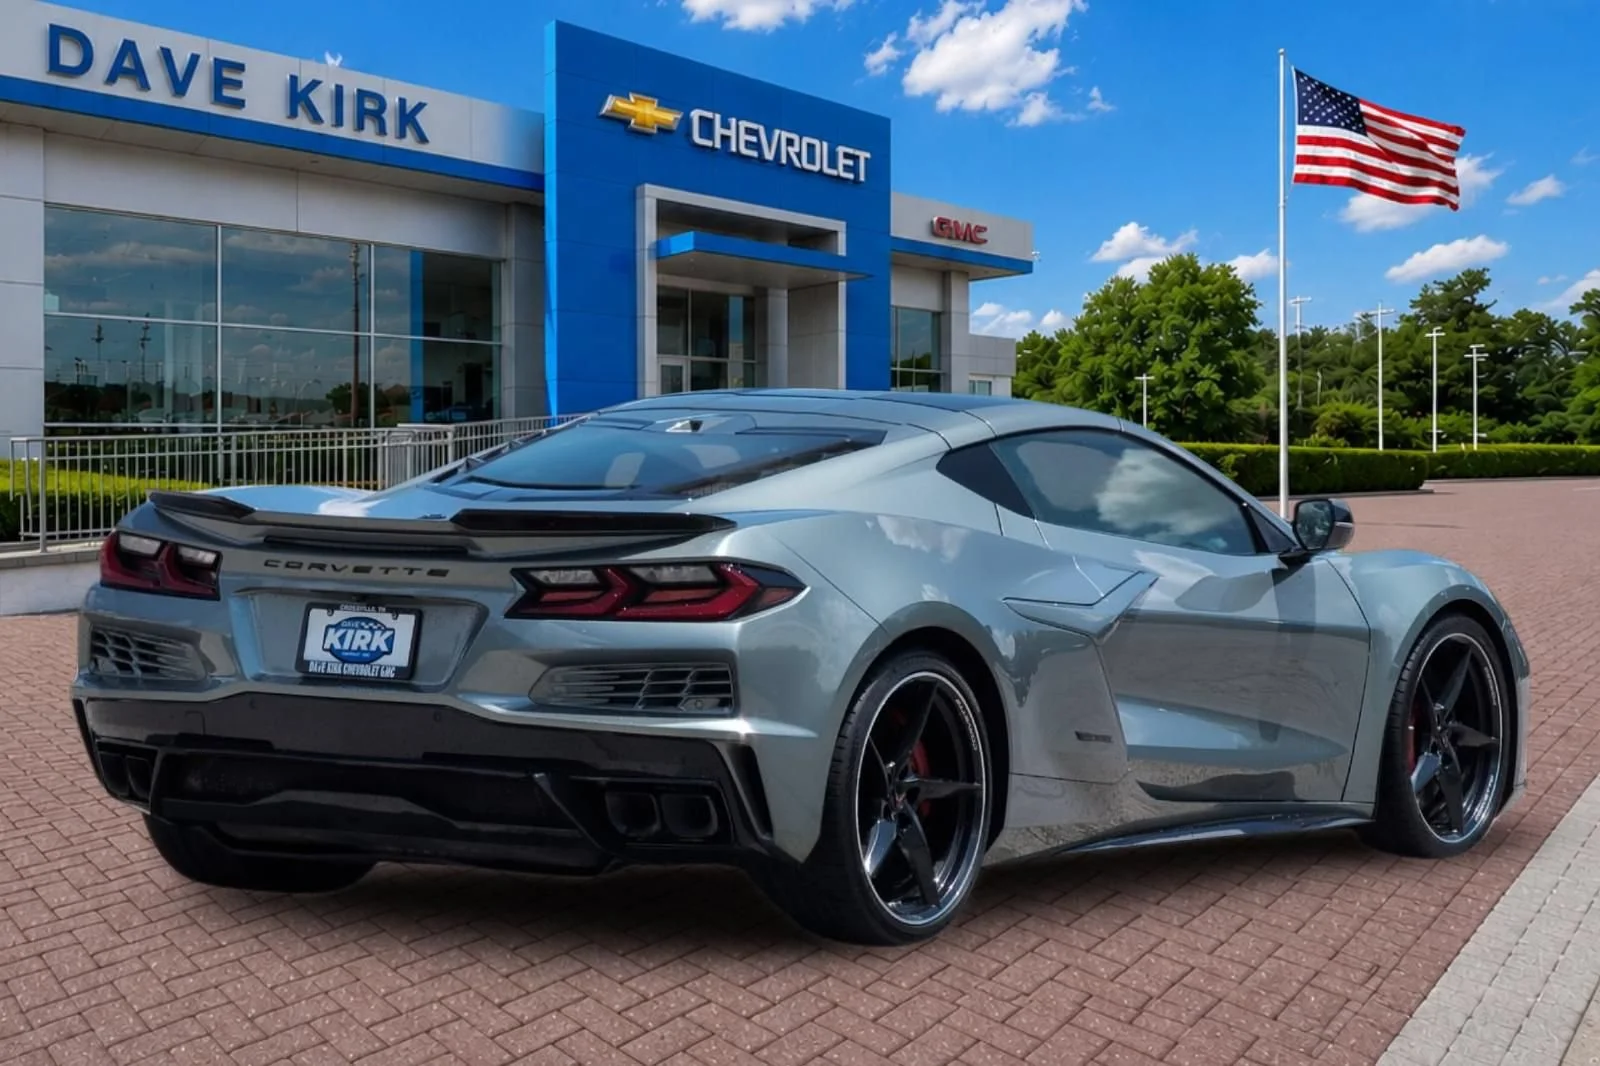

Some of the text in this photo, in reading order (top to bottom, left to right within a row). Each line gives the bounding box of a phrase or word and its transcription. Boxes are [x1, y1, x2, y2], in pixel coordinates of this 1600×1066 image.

[48, 23, 430, 144] DAVE KIRK
[690, 108, 871, 183] CHEVROLET
[932, 216, 988, 244] GMC
[264, 558, 450, 578] CORVETTE
[323, 627, 394, 652] KIRK
[308, 660, 397, 678] DAVE KIRK CHEVROLET GMC
